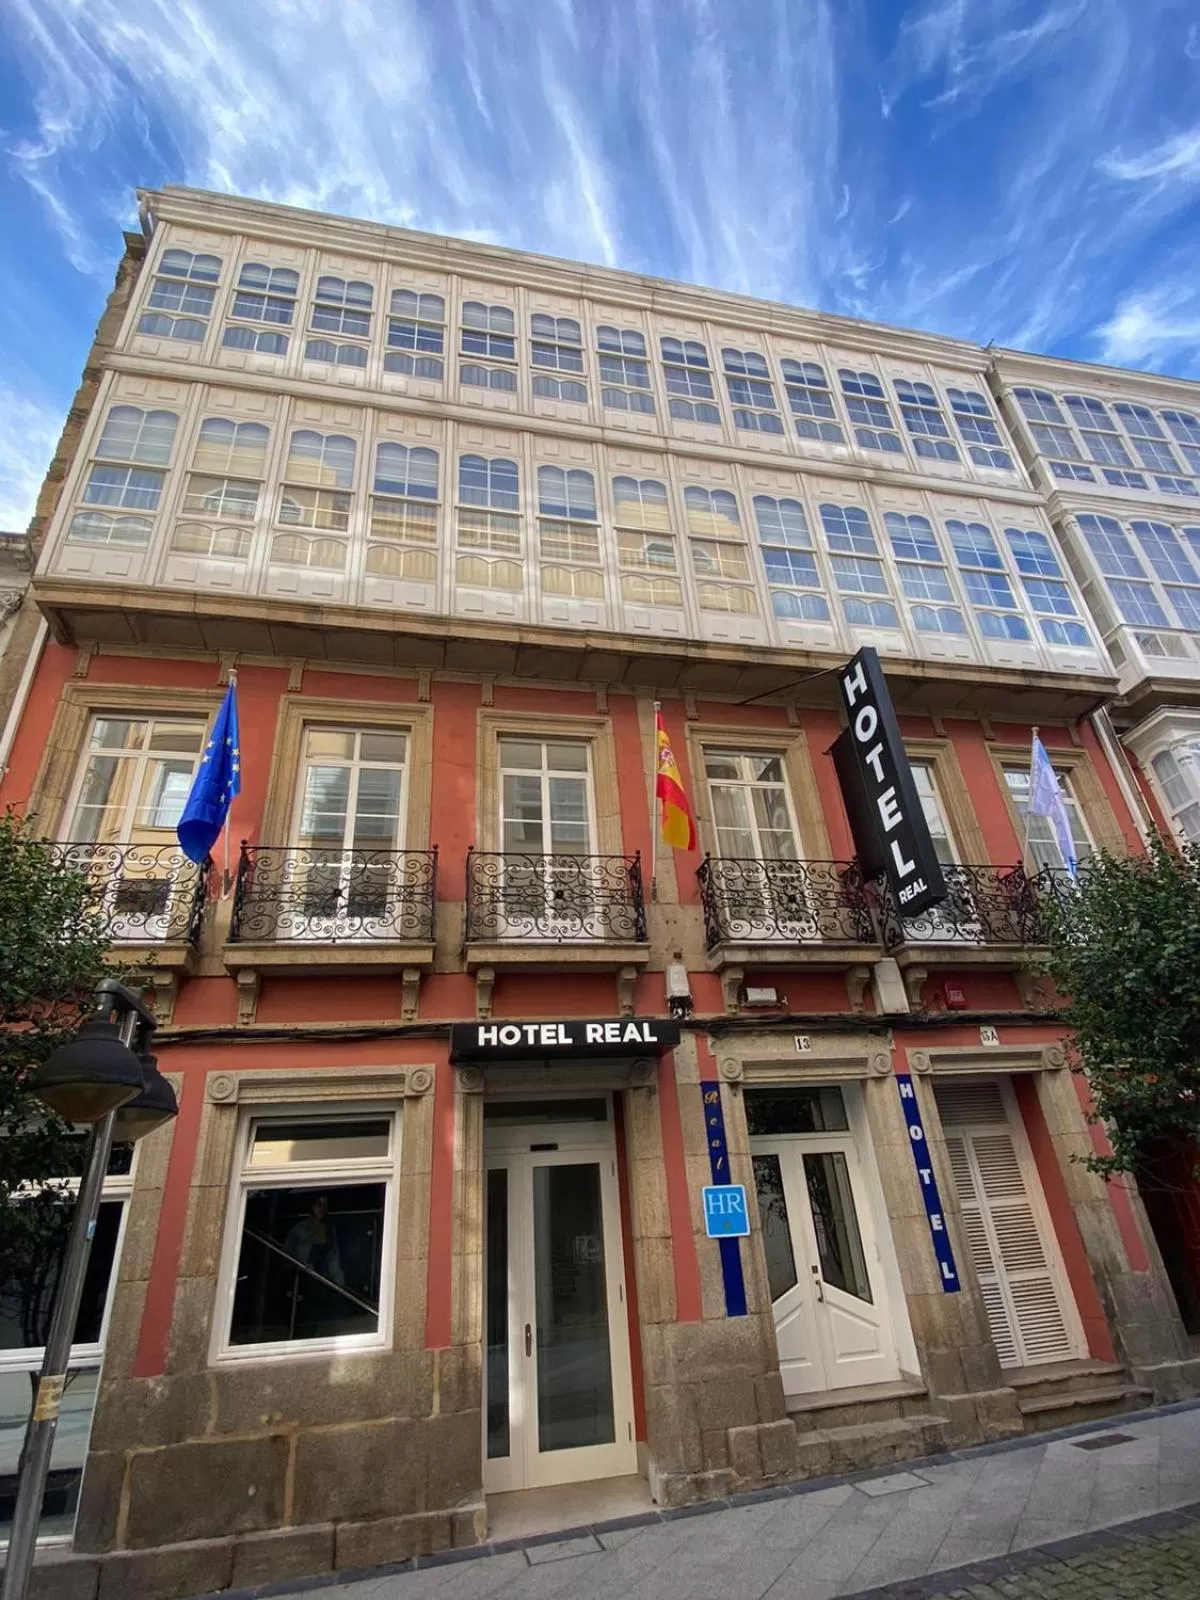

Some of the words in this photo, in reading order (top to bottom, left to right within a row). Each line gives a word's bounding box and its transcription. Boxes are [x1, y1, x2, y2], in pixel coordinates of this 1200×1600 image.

[843, 661, 916, 879] HOTEL
[898, 877, 928, 904] REAL
[478, 1025, 572, 1046] HOTEL
[586, 1022, 658, 1043] REAL
[797, 1038, 810, 1050] 13
[704, 1090, 723, 1170] Real
[900, 1083, 954, 1279] HOTEL
[708, 1192, 744, 1216] HR
